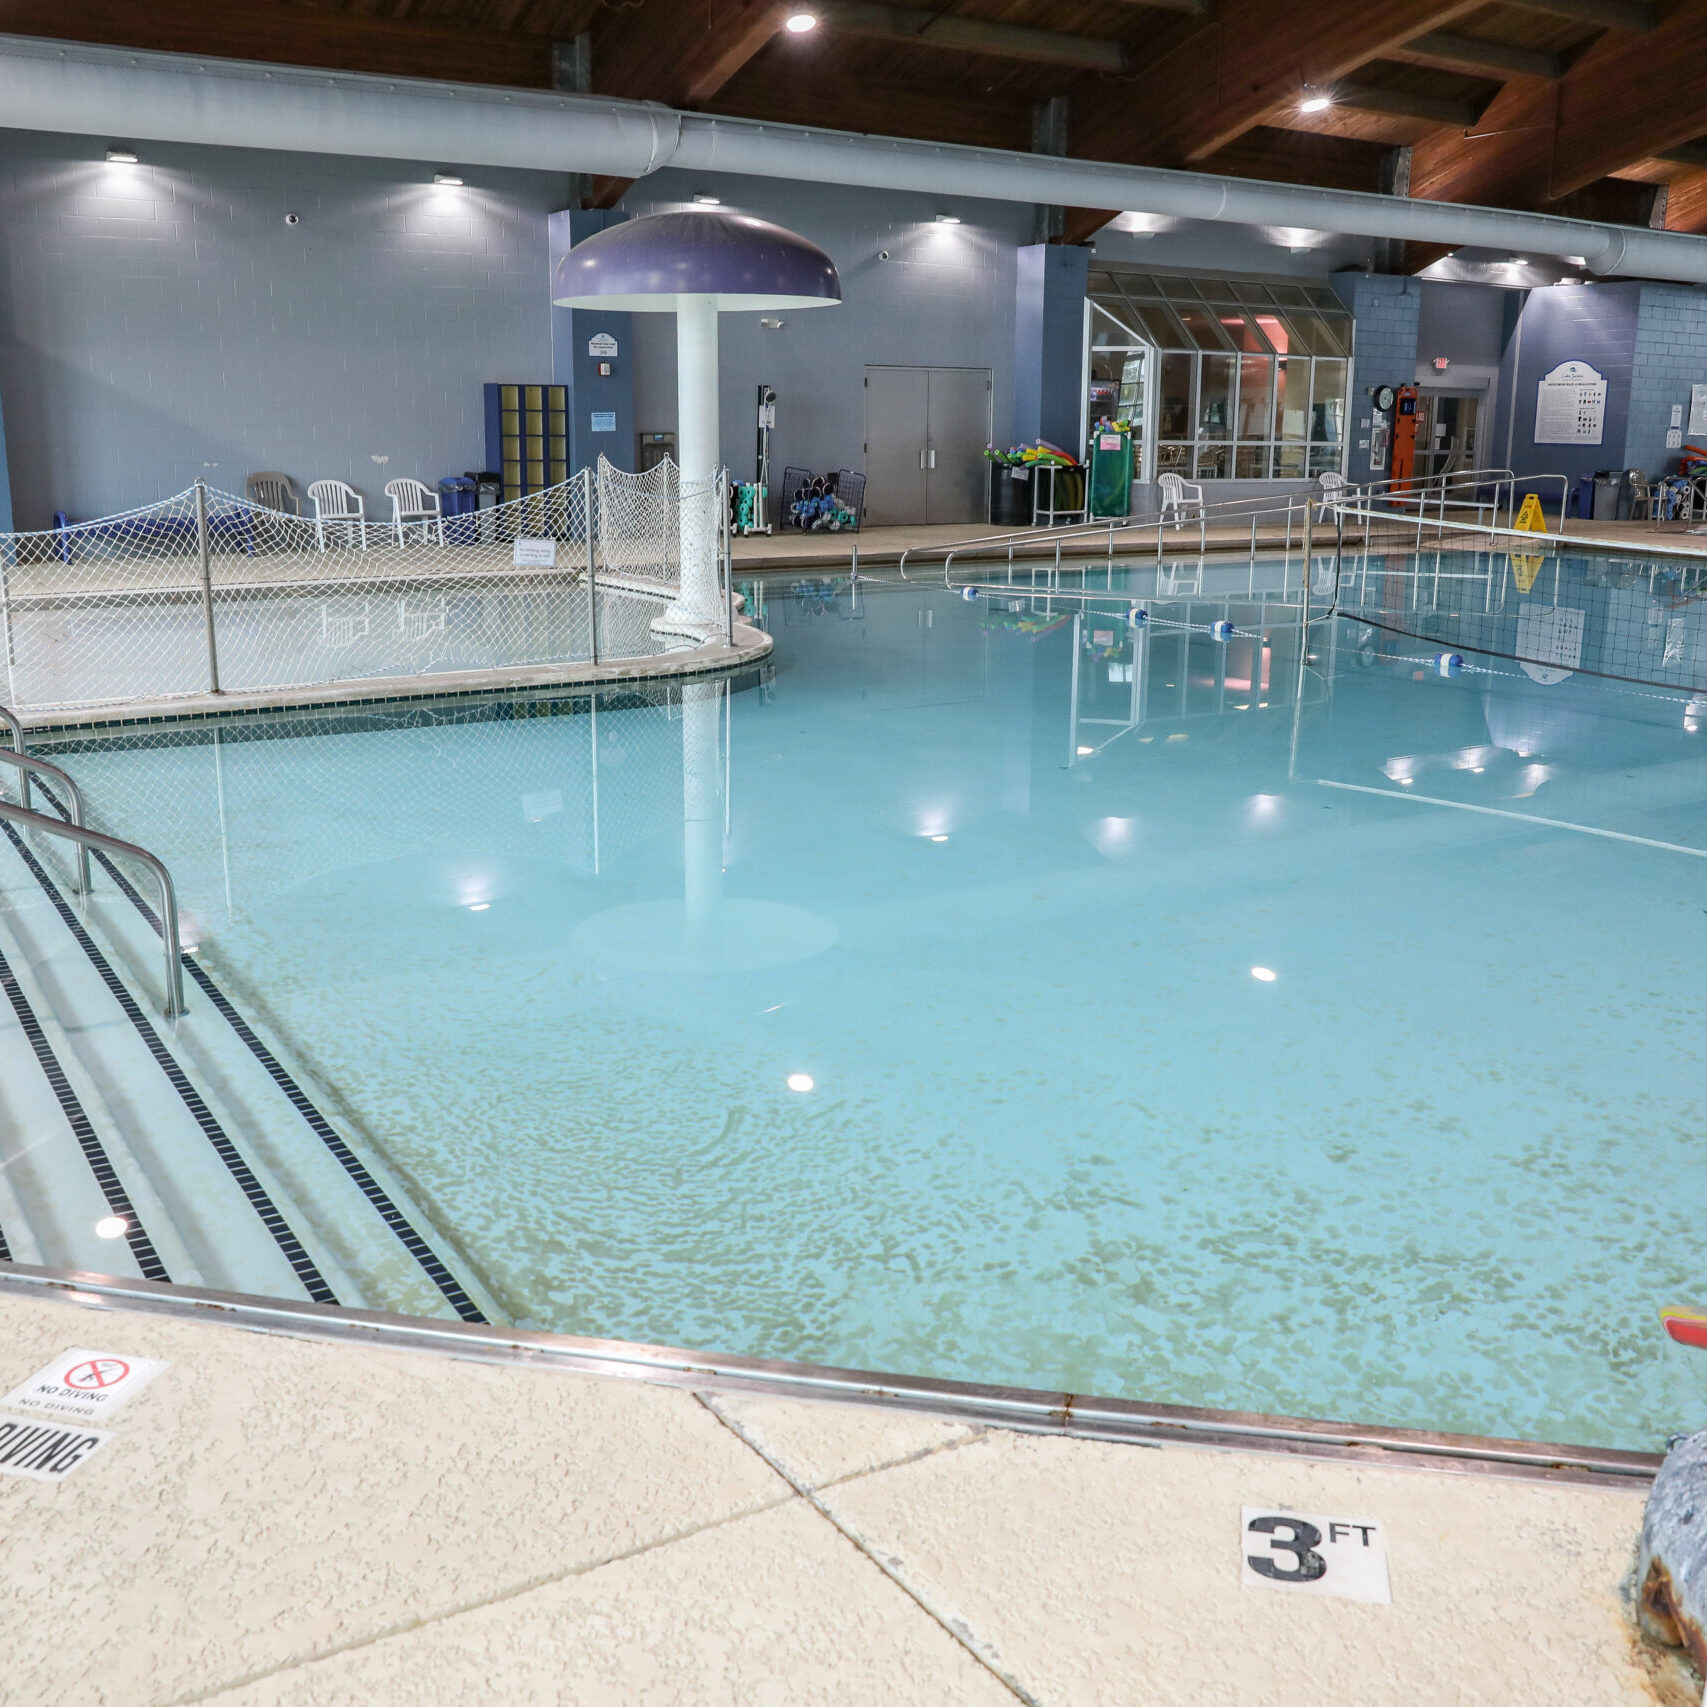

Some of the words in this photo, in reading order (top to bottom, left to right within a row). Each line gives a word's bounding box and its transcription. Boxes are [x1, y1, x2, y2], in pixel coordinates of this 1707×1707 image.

[37, 1384, 59, 1395] NO
[59, 1388, 109, 1403] DIVING
[18, 1398, 41, 1407] NO
[44, 1402, 95, 1416] DIVING
[1247, 1516, 1327, 1583] 3
[1329, 1522, 1377, 1547] FT
